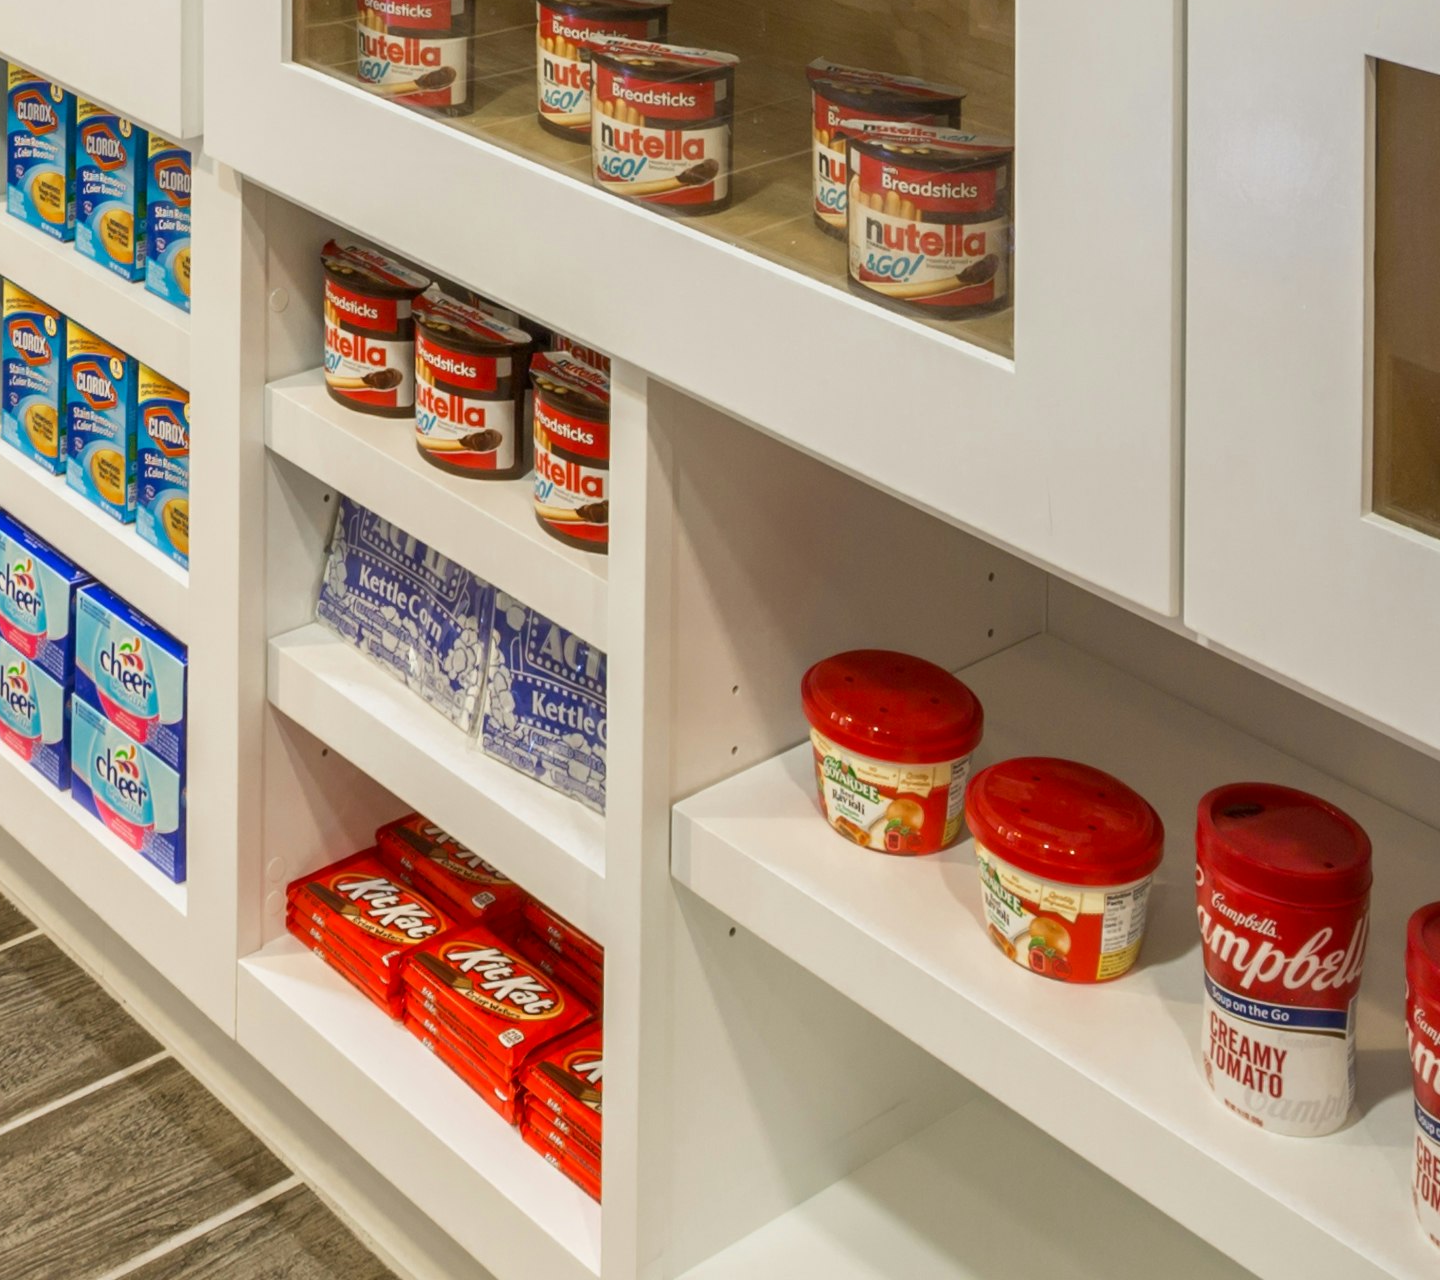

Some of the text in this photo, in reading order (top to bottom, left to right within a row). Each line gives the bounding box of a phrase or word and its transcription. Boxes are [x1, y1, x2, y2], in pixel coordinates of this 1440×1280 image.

[359, 30, 441, 68] nutella
[612, 82, 696, 108] Breadsticks
[601, 119, 705, 161] nutella
[159, 170, 191, 193] CLORO
[601, 156, 647, 182] &GO!
[882, 173, 977, 199] Breadsticks
[866, 216, 986, 258] nutella
[866, 253, 924, 283] &GO!
[144, 454, 163, 468] Stain
[359, 564, 406, 609] Kettle
[409, 596, 442, 642] Corn
[100, 642, 152, 700] cheer
[532, 690, 595, 735] Kettle
[96, 748, 147, 808] cheer
[824, 766, 880, 804] BOYARDEE
[832, 789, 865, 815] Ravioli
[1211, 891, 1277, 938] Campbell's
[465, 989, 488, 1006] Crisp
[1211, 986, 1290, 1021] Soup on the Go
[1210, 1010, 1287, 1073] CREAMY
[1210, 1034, 1284, 1099] TOMATO
